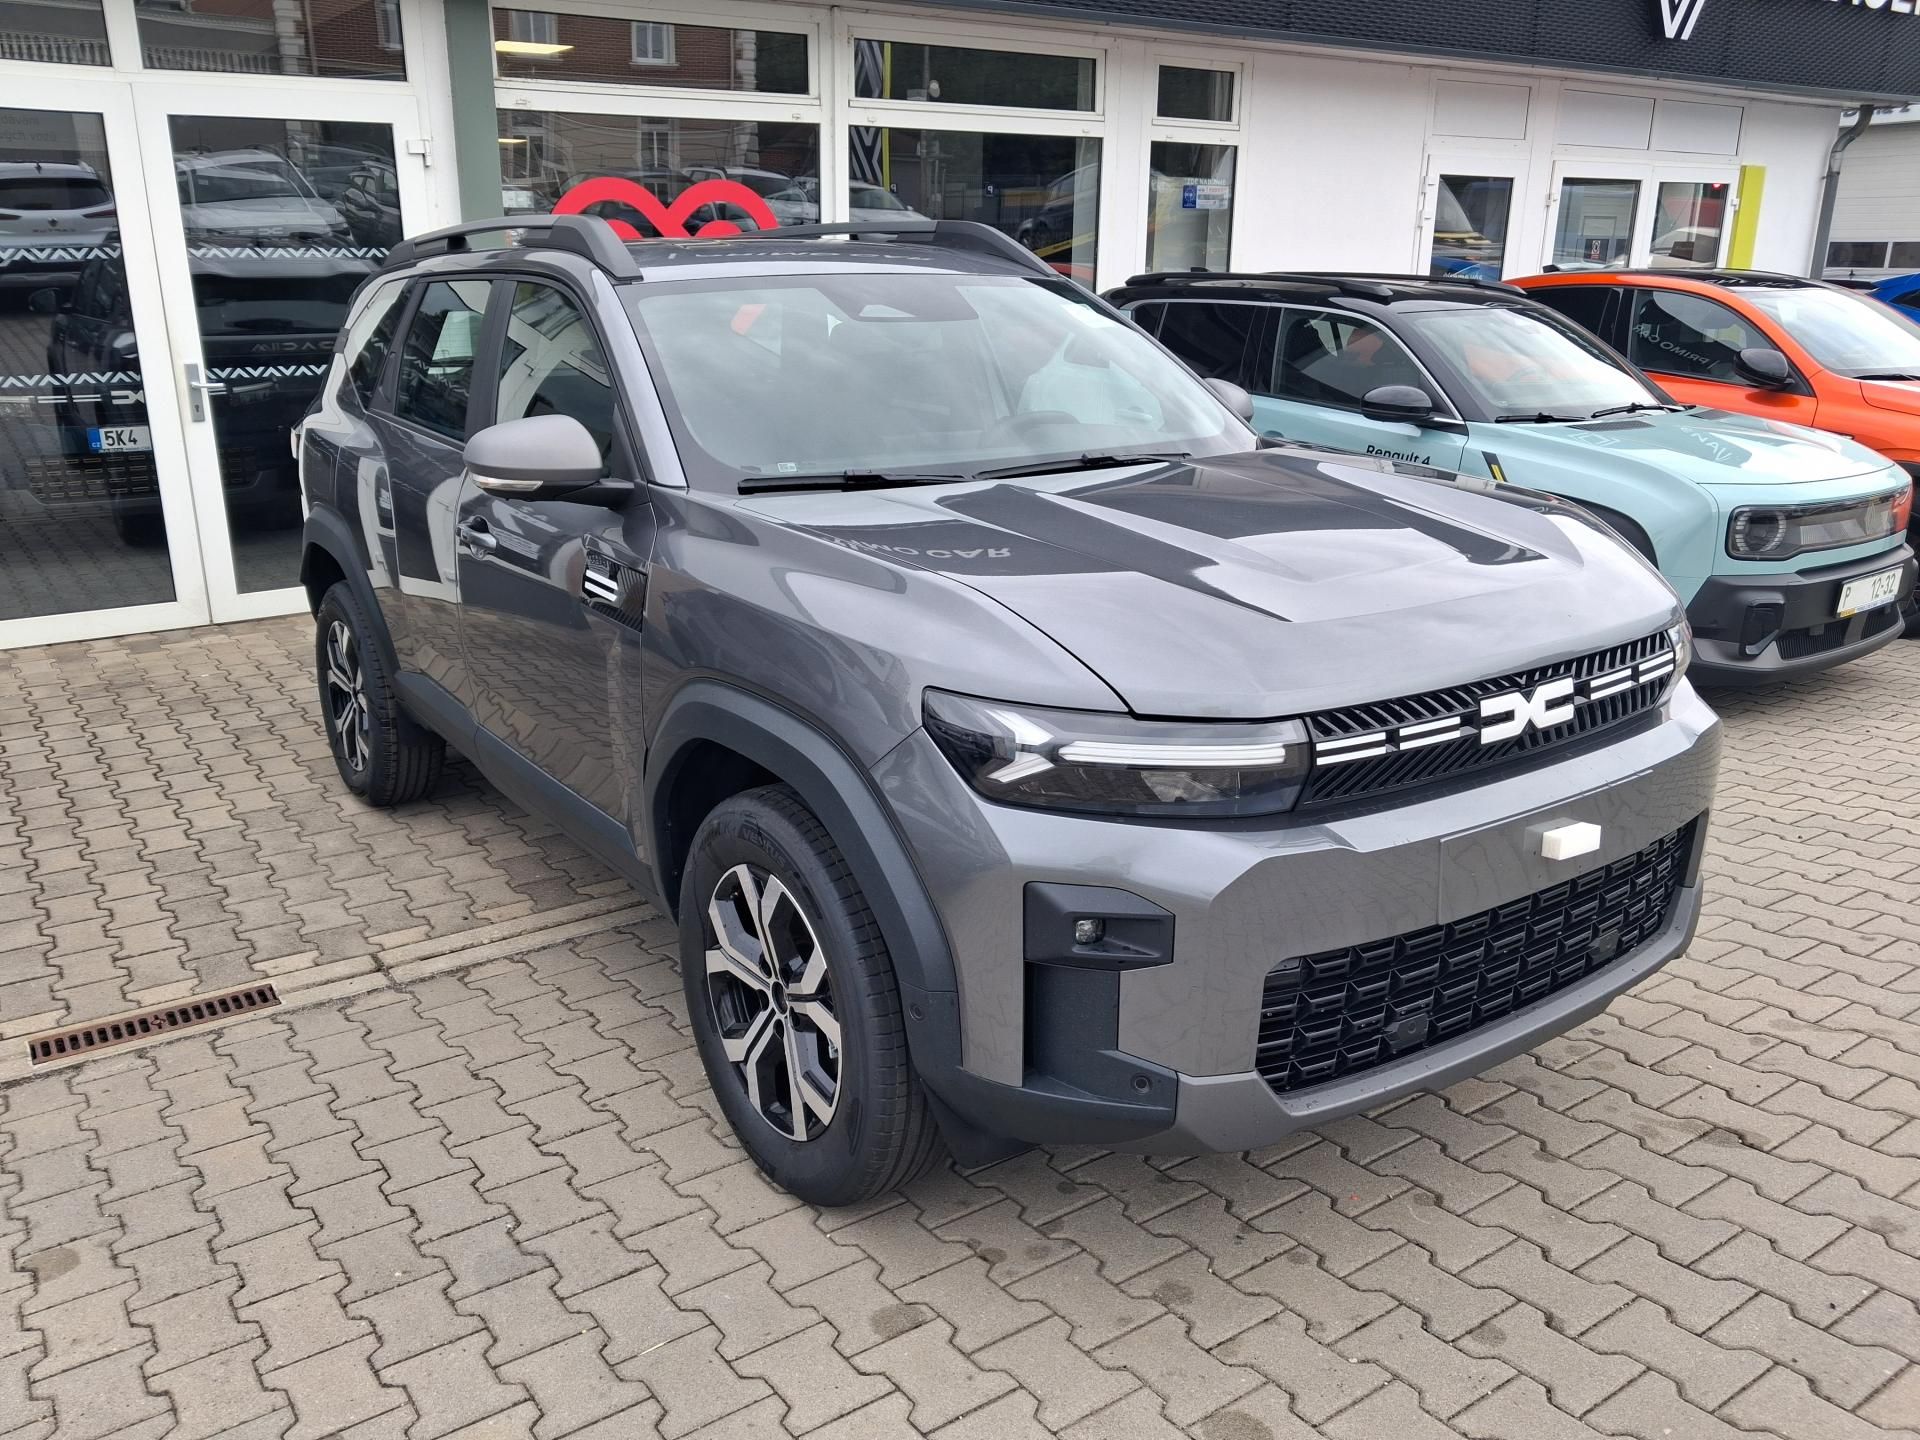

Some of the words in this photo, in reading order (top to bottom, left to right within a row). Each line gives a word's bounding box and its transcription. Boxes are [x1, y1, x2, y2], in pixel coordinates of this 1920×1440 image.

[104, 429, 138, 447] 5K4
[1366, 444, 1420, 463] Renault
[1421, 455, 1431, 465] 4
[1843, 586, 1851, 608] P
[1870, 573, 1897, 600] 12-32
